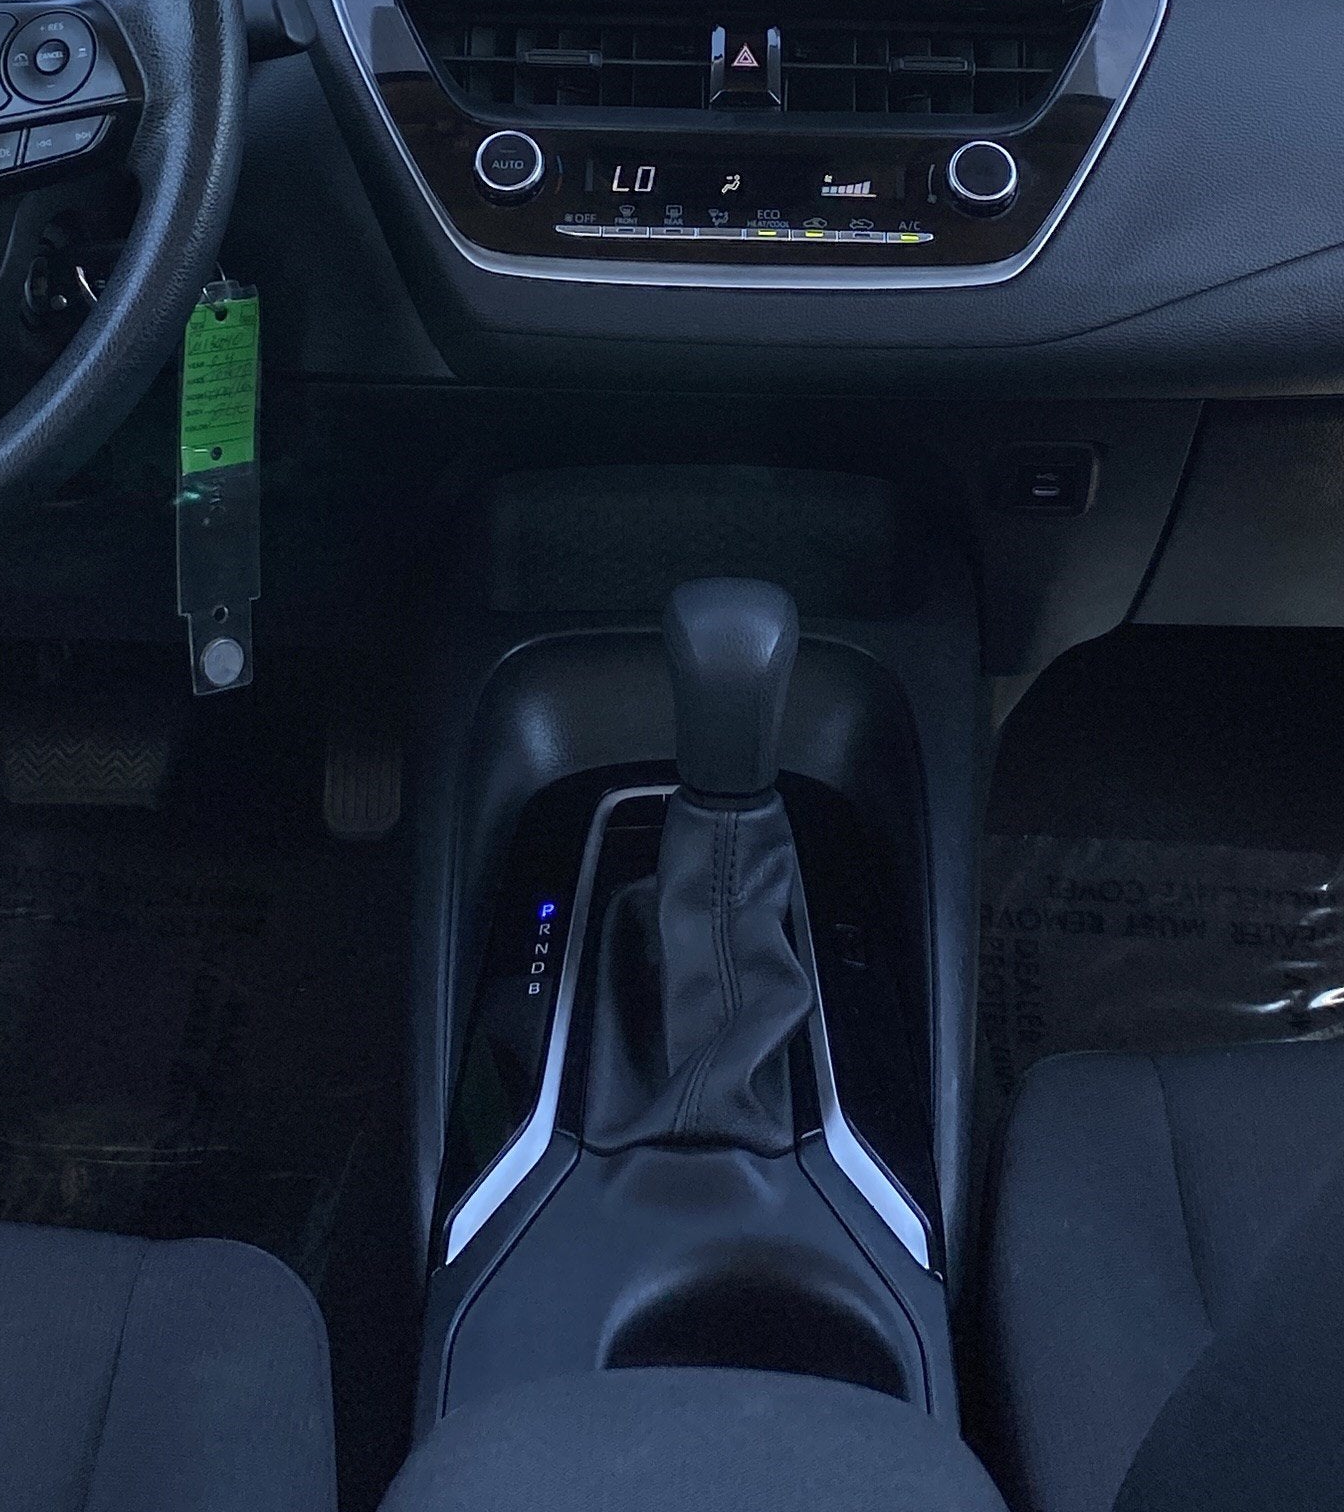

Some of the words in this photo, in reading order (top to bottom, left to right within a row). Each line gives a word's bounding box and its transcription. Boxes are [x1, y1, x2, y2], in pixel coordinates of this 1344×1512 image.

[48, 22, 64, 32] RES
[39, 51, 64, 59] CANCEL
[491, 159, 524, 170] AUTO
[611, 165, 656, 192] LO
[575, 213, 597, 224] OFF
[757, 210, 781, 220] ECO
[614, 217, 638, 225] FRONT
[664, 217, 684, 225] REAR
[746, 220, 789, 228] HEAT/COOL
[899, 220, 921, 231] A/C
[542, 904, 554, 917] P
[539, 923, 551, 935] R
[535, 942, 549, 955] N
[531, 961, 545, 974] D
[528, 982, 540, 995] B
